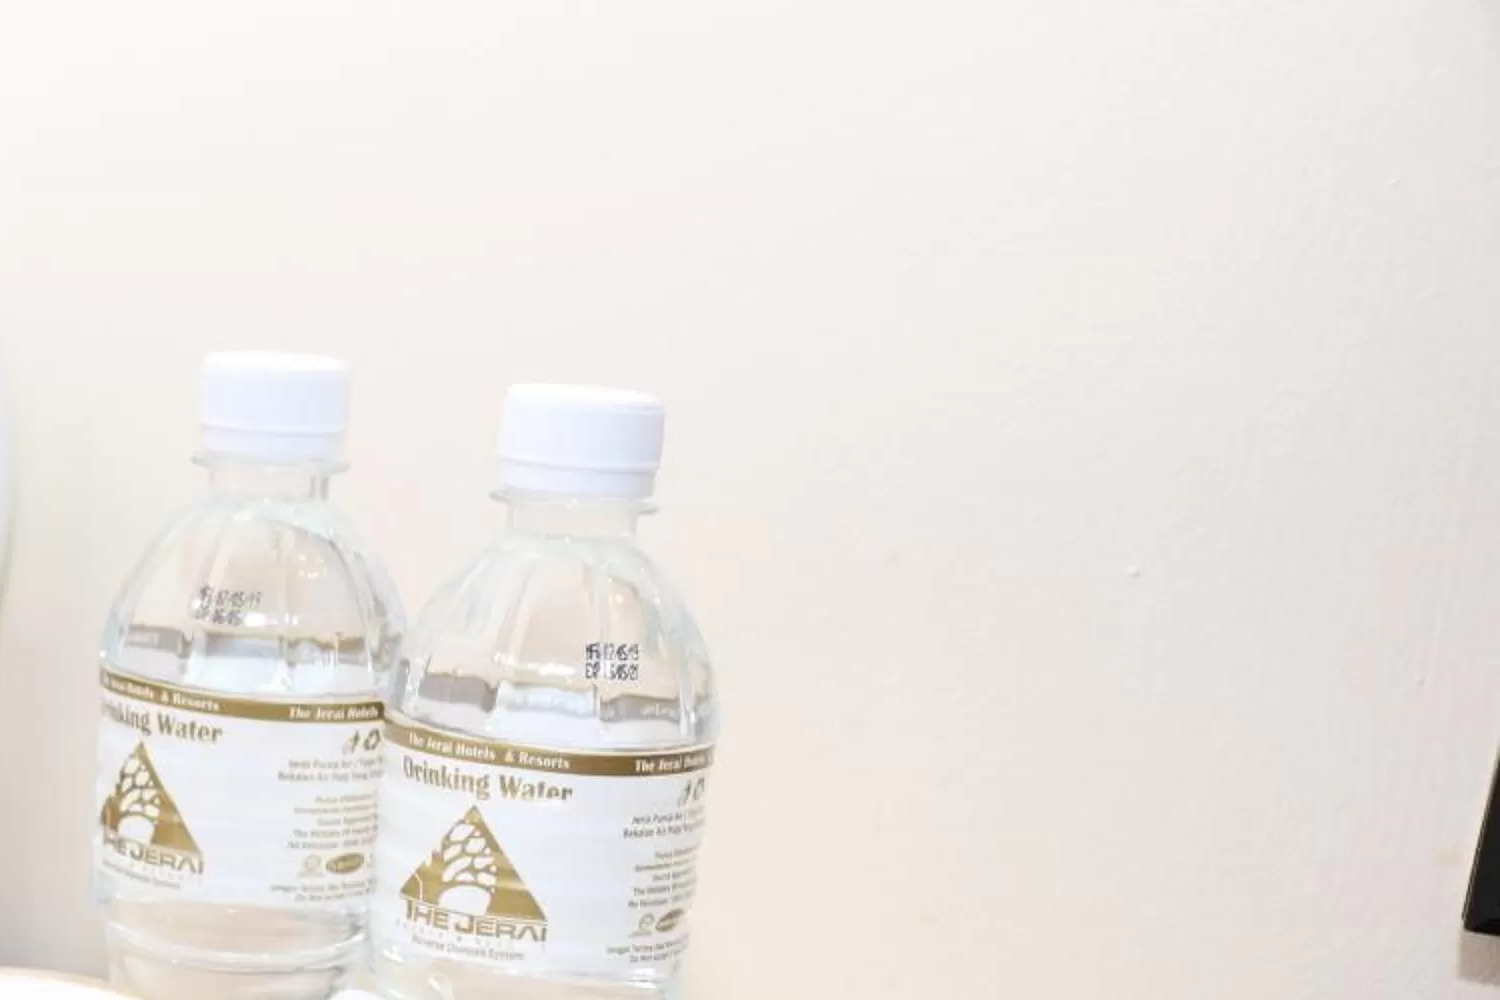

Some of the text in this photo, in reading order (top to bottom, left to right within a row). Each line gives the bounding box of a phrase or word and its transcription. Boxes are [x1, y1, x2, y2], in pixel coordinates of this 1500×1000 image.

[157, 711, 223, 743] Water
[408, 732, 424, 746] The
[456, 742, 495, 761] Hotels
[505, 750, 514, 762] &
[519, 752, 570, 769] Resorts
[635, 759, 654, 772] The
[403, 754, 573, 801] Drinking Water
[405, 899, 449, 930] THE
[455, 915, 548, 942] JERAI
